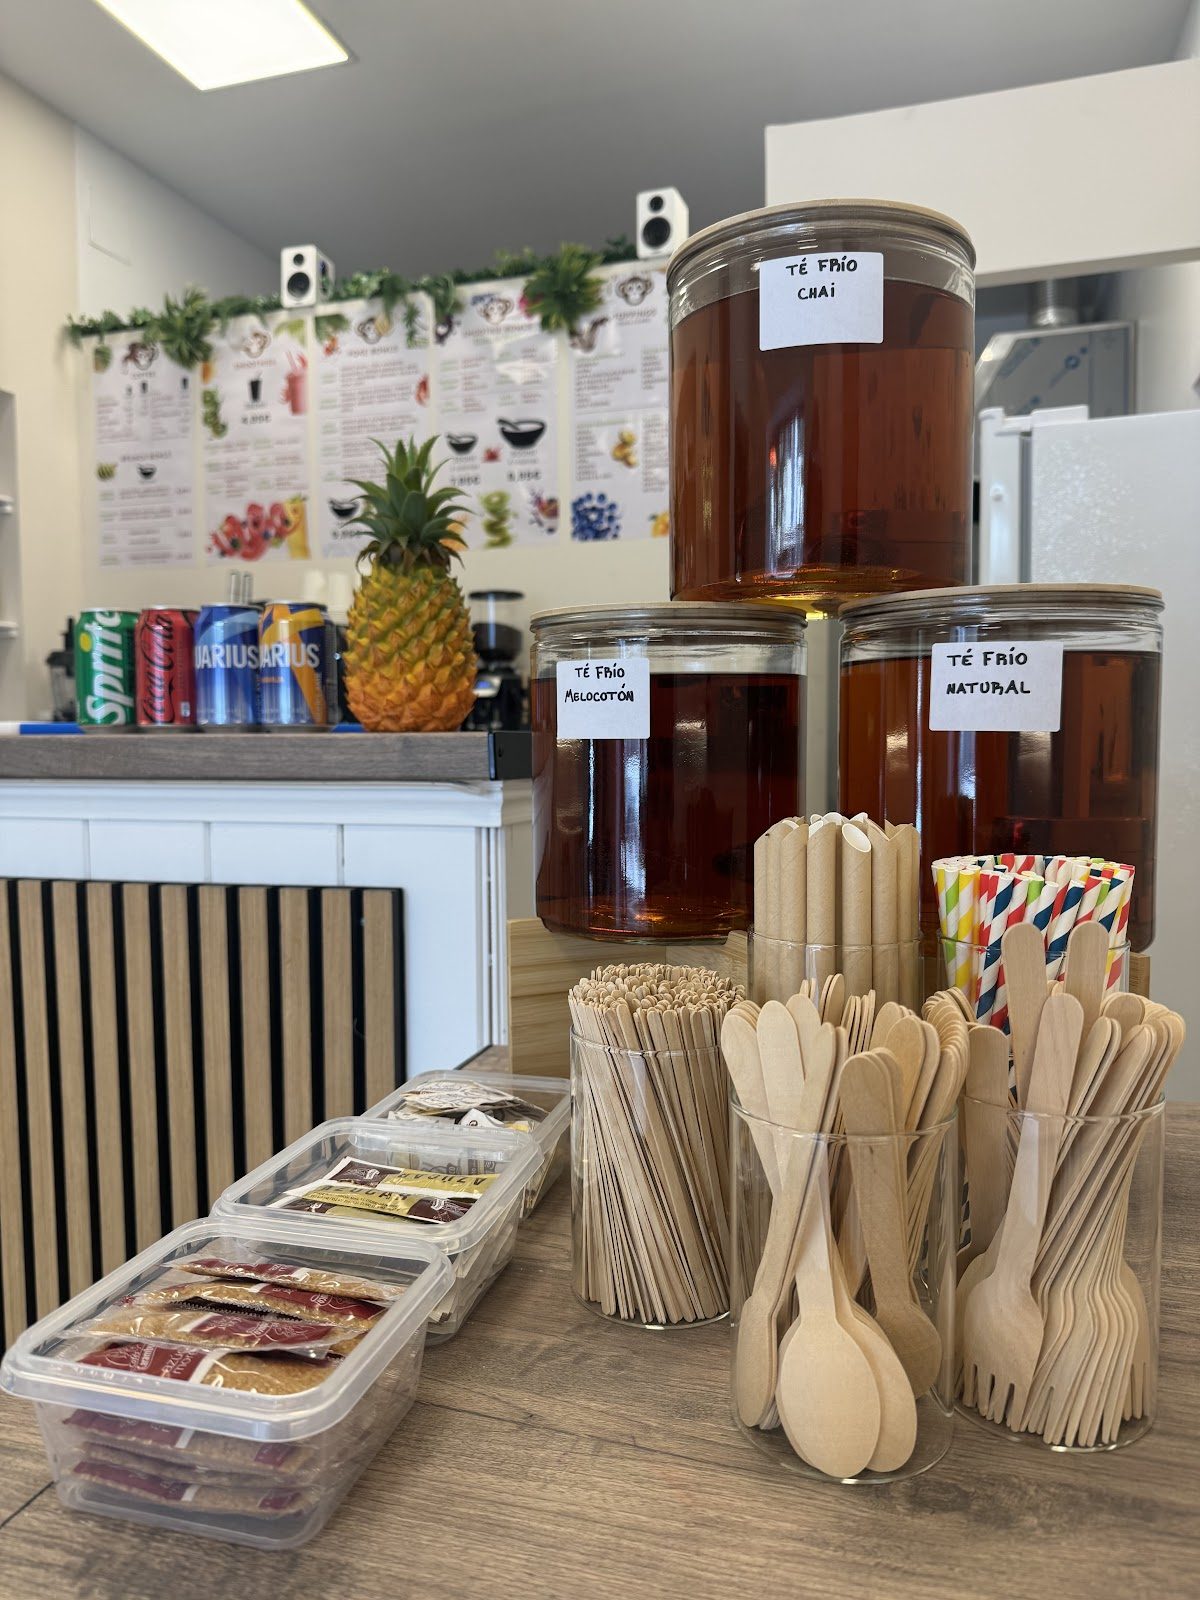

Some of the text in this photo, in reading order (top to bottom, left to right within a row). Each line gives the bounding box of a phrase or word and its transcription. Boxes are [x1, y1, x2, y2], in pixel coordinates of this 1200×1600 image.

[785, 255, 858, 276] TÉ FRÍO
[946, 647, 1028, 667] TÉ FRÍO
[86, 612, 134, 723] Sprite
[574, 662, 625, 679] TÉ FRÍO
[564, 683, 634, 702] MELOCOTÓN
[946, 680, 1031, 696] NATURAL
